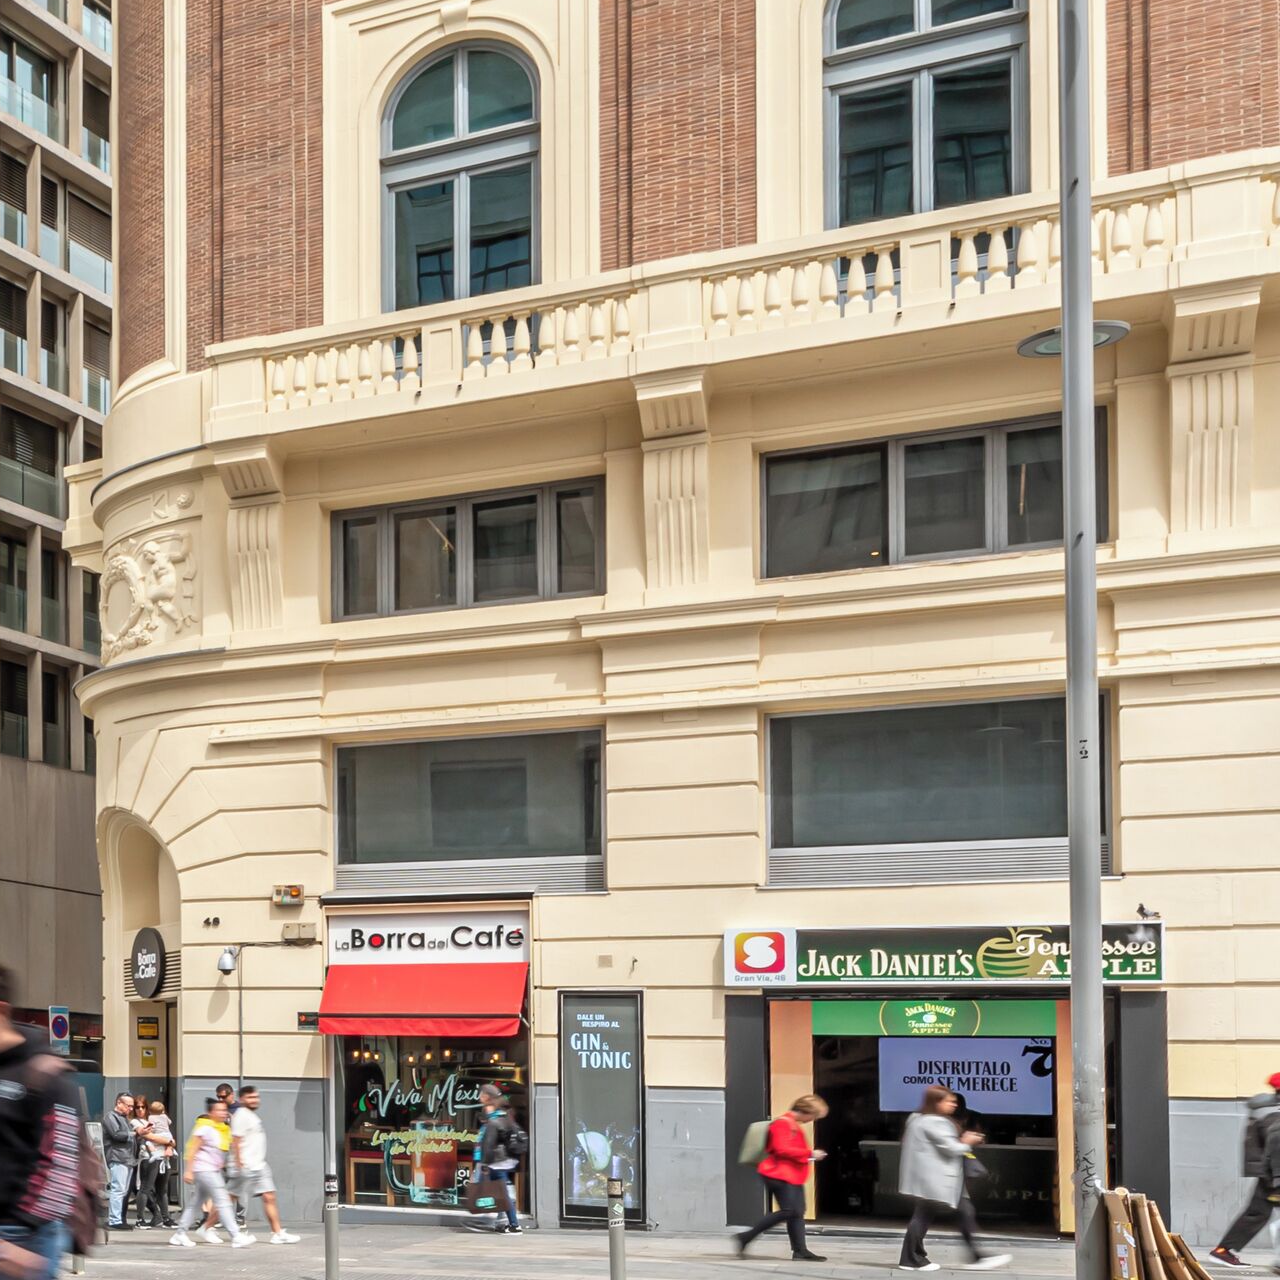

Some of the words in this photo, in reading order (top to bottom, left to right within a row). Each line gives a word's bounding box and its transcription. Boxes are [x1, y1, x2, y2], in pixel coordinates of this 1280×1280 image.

[335, 940, 350, 951] La
[351, 928, 426, 950] Borra
[428, 938, 449, 950] del
[451, 925, 525, 949] Café
[1016, 933, 1156, 956] Tenssee
[798, 949, 864, 976] JACK
[869, 948, 975, 976] DANIEL'S
[1037, 958, 1157, 975] ALE
[905, 1005, 924, 1017] JACK
[570, 1033, 600, 1050] GIN
[578, 1051, 631, 1069] TONIC
[1021, 1045, 1052, 1077] 7
[903, 1076, 934, 1084] COMO
[937, 1077, 954, 1090] SE
[958, 1077, 1018, 1092] MERECE
[369, 1079, 423, 1117] Viva
[428, 1073, 481, 1116] Méxi
[991, 1190, 1049, 1201] APPL
